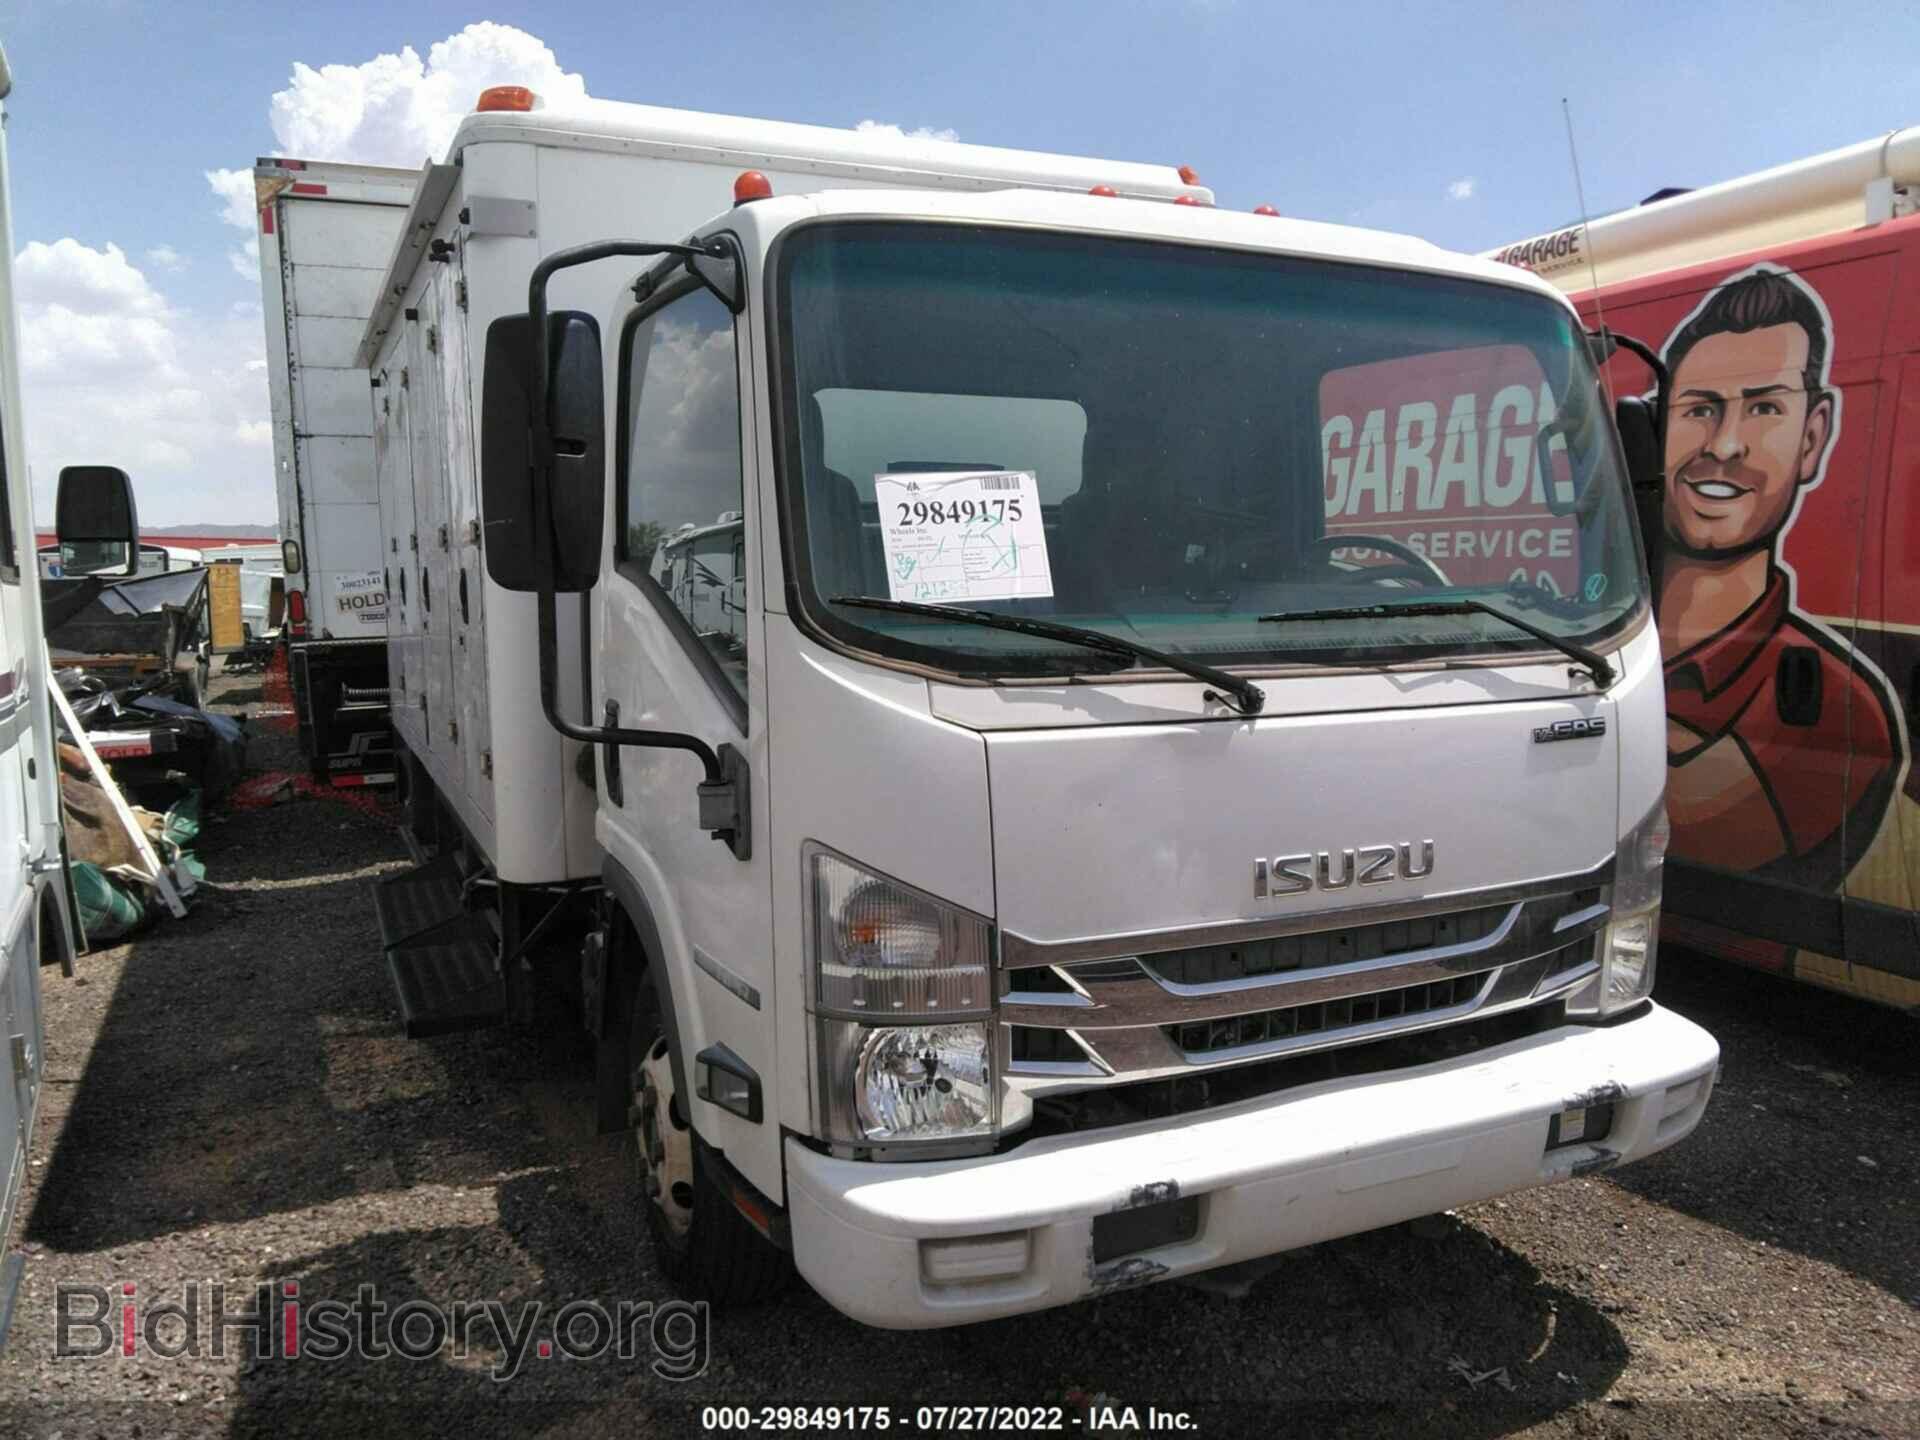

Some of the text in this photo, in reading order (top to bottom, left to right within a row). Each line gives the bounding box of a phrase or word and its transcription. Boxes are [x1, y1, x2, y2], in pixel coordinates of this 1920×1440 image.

[1507, 227, 1584, 267] GARAGE
[1320, 381, 1576, 519] GARAGE
[896, 498, 1023, 528] 29849175
[1406, 528, 1574, 560] SERVICE
[338, 592, 385, 611] HOLD
[1253, 838, 1436, 900] ISUZU
